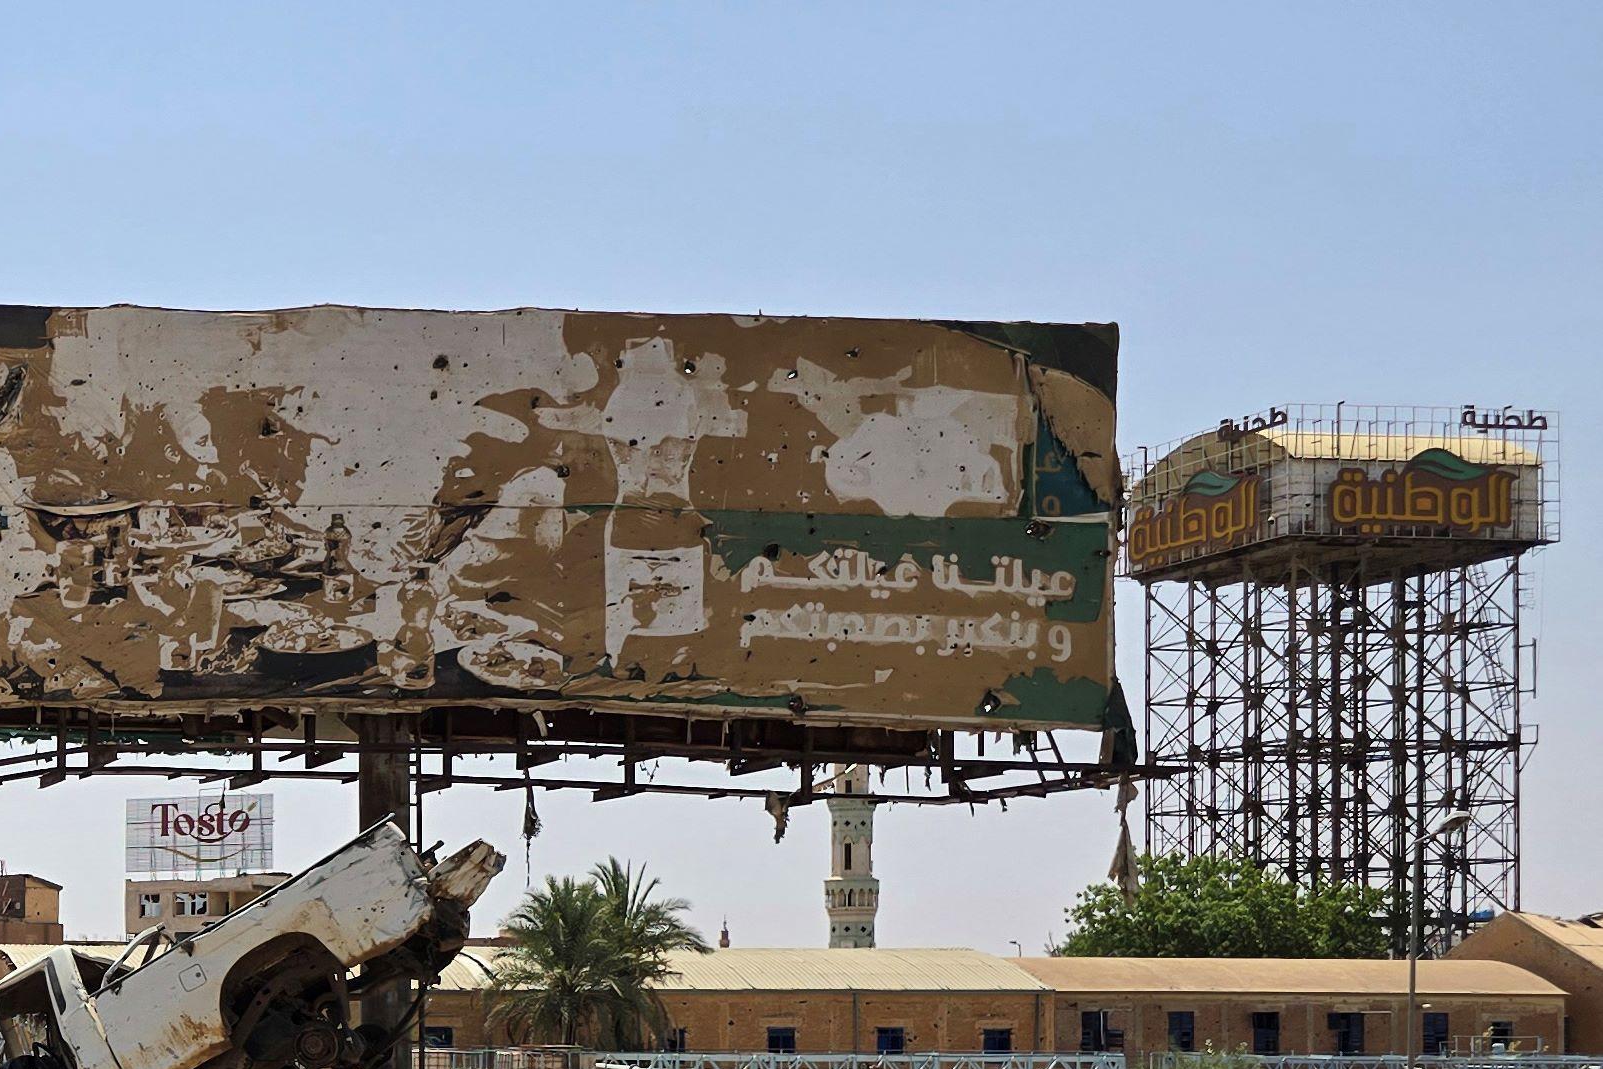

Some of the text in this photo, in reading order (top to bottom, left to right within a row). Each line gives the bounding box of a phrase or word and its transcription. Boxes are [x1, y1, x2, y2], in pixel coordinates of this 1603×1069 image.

[1131, 478, 1259, 566] الوطنية
[1333, 473, 1510, 535] الوطنية
[151, 802, 250, 843] Tosto
